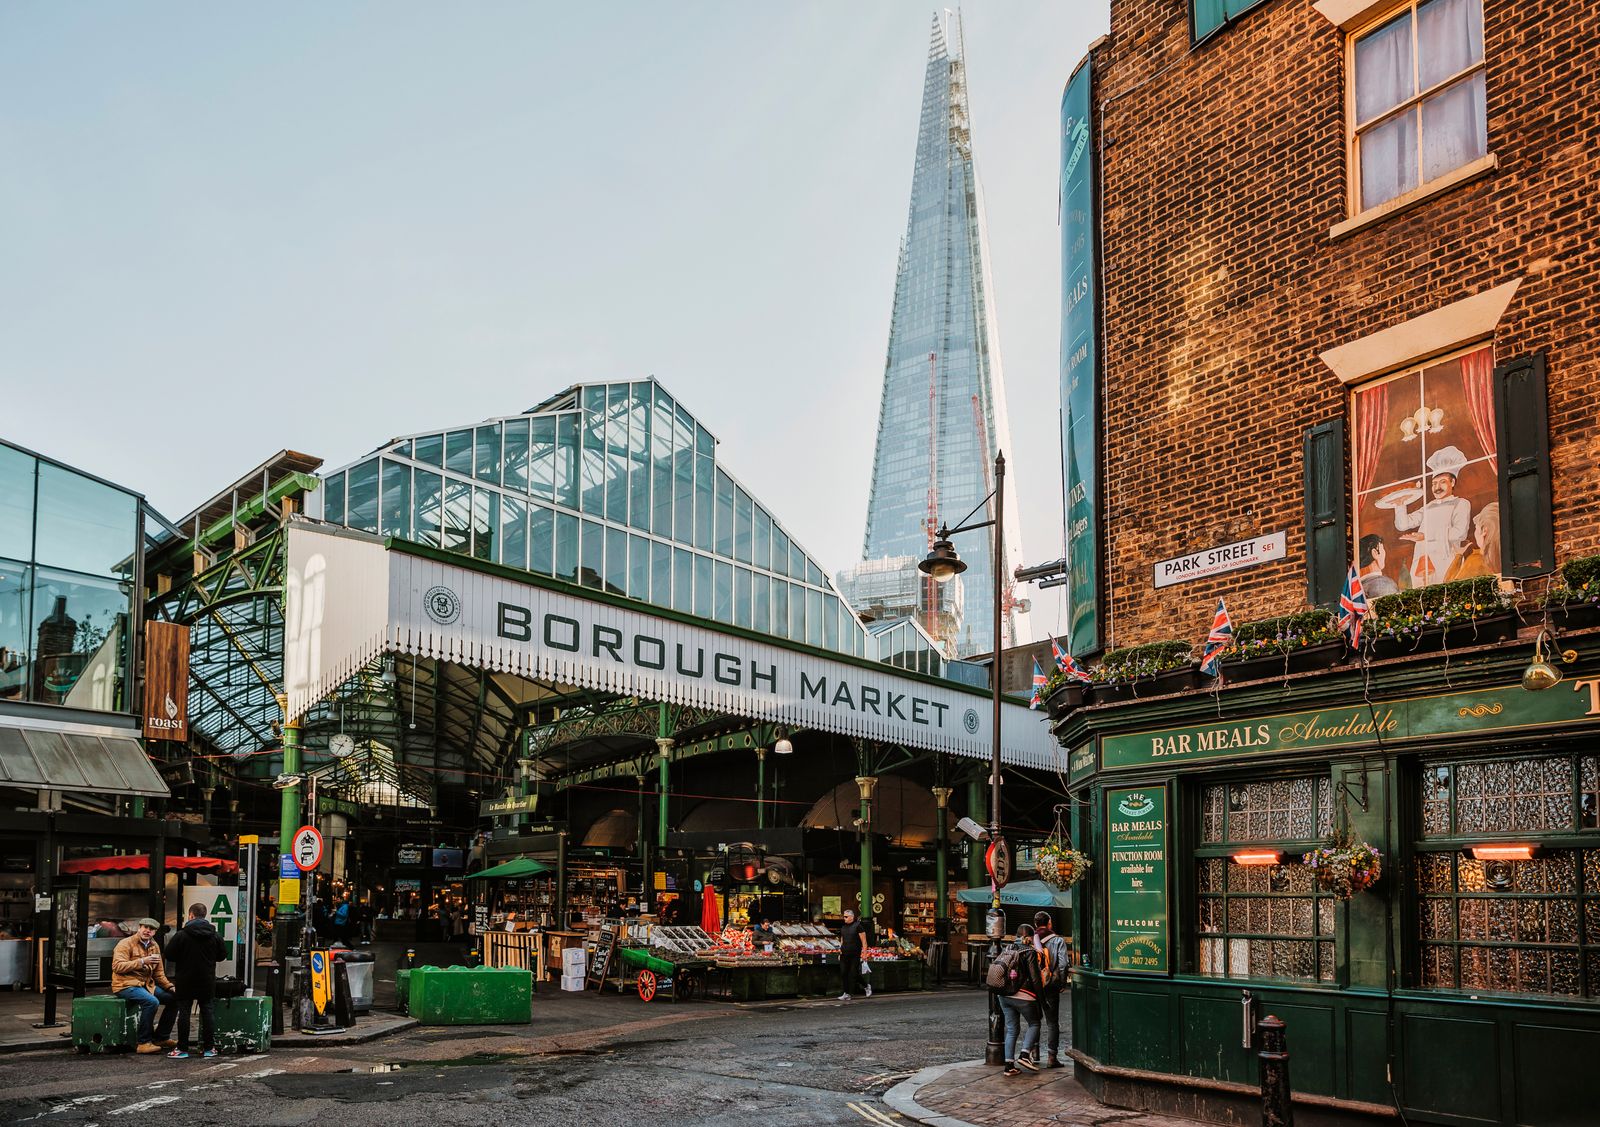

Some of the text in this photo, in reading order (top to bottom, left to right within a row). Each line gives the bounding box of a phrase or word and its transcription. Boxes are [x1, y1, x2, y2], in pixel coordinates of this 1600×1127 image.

[1165, 542, 1275, 576] PARK STREET SE1
[1176, 572, 1196, 581] LONDON
[1197, 566, 1221, 576] BOROUGH
[1230, 556, 1259, 567] SOUTHWARK
[497, 601, 950, 728] BOROUGH MARKET
[149, 717, 183, 729] roast
[1151, 709, 1399, 757] BAR MEALS Available
[1127, 793, 1145, 801] THE
[1112, 820, 1162, 832] BAR MEALS
[1117, 831, 1154, 841] Available
[1112, 850, 1163, 861] FUNCTION ROOM
[1121, 863, 1154, 874] available for
[1131, 877, 1143, 887] hire
[1117, 919, 1160, 927] WELCOME
[1115, 935, 1161, 955] RESERVATIONS
[1119, 956, 1158, 966] 020 7407 2495
